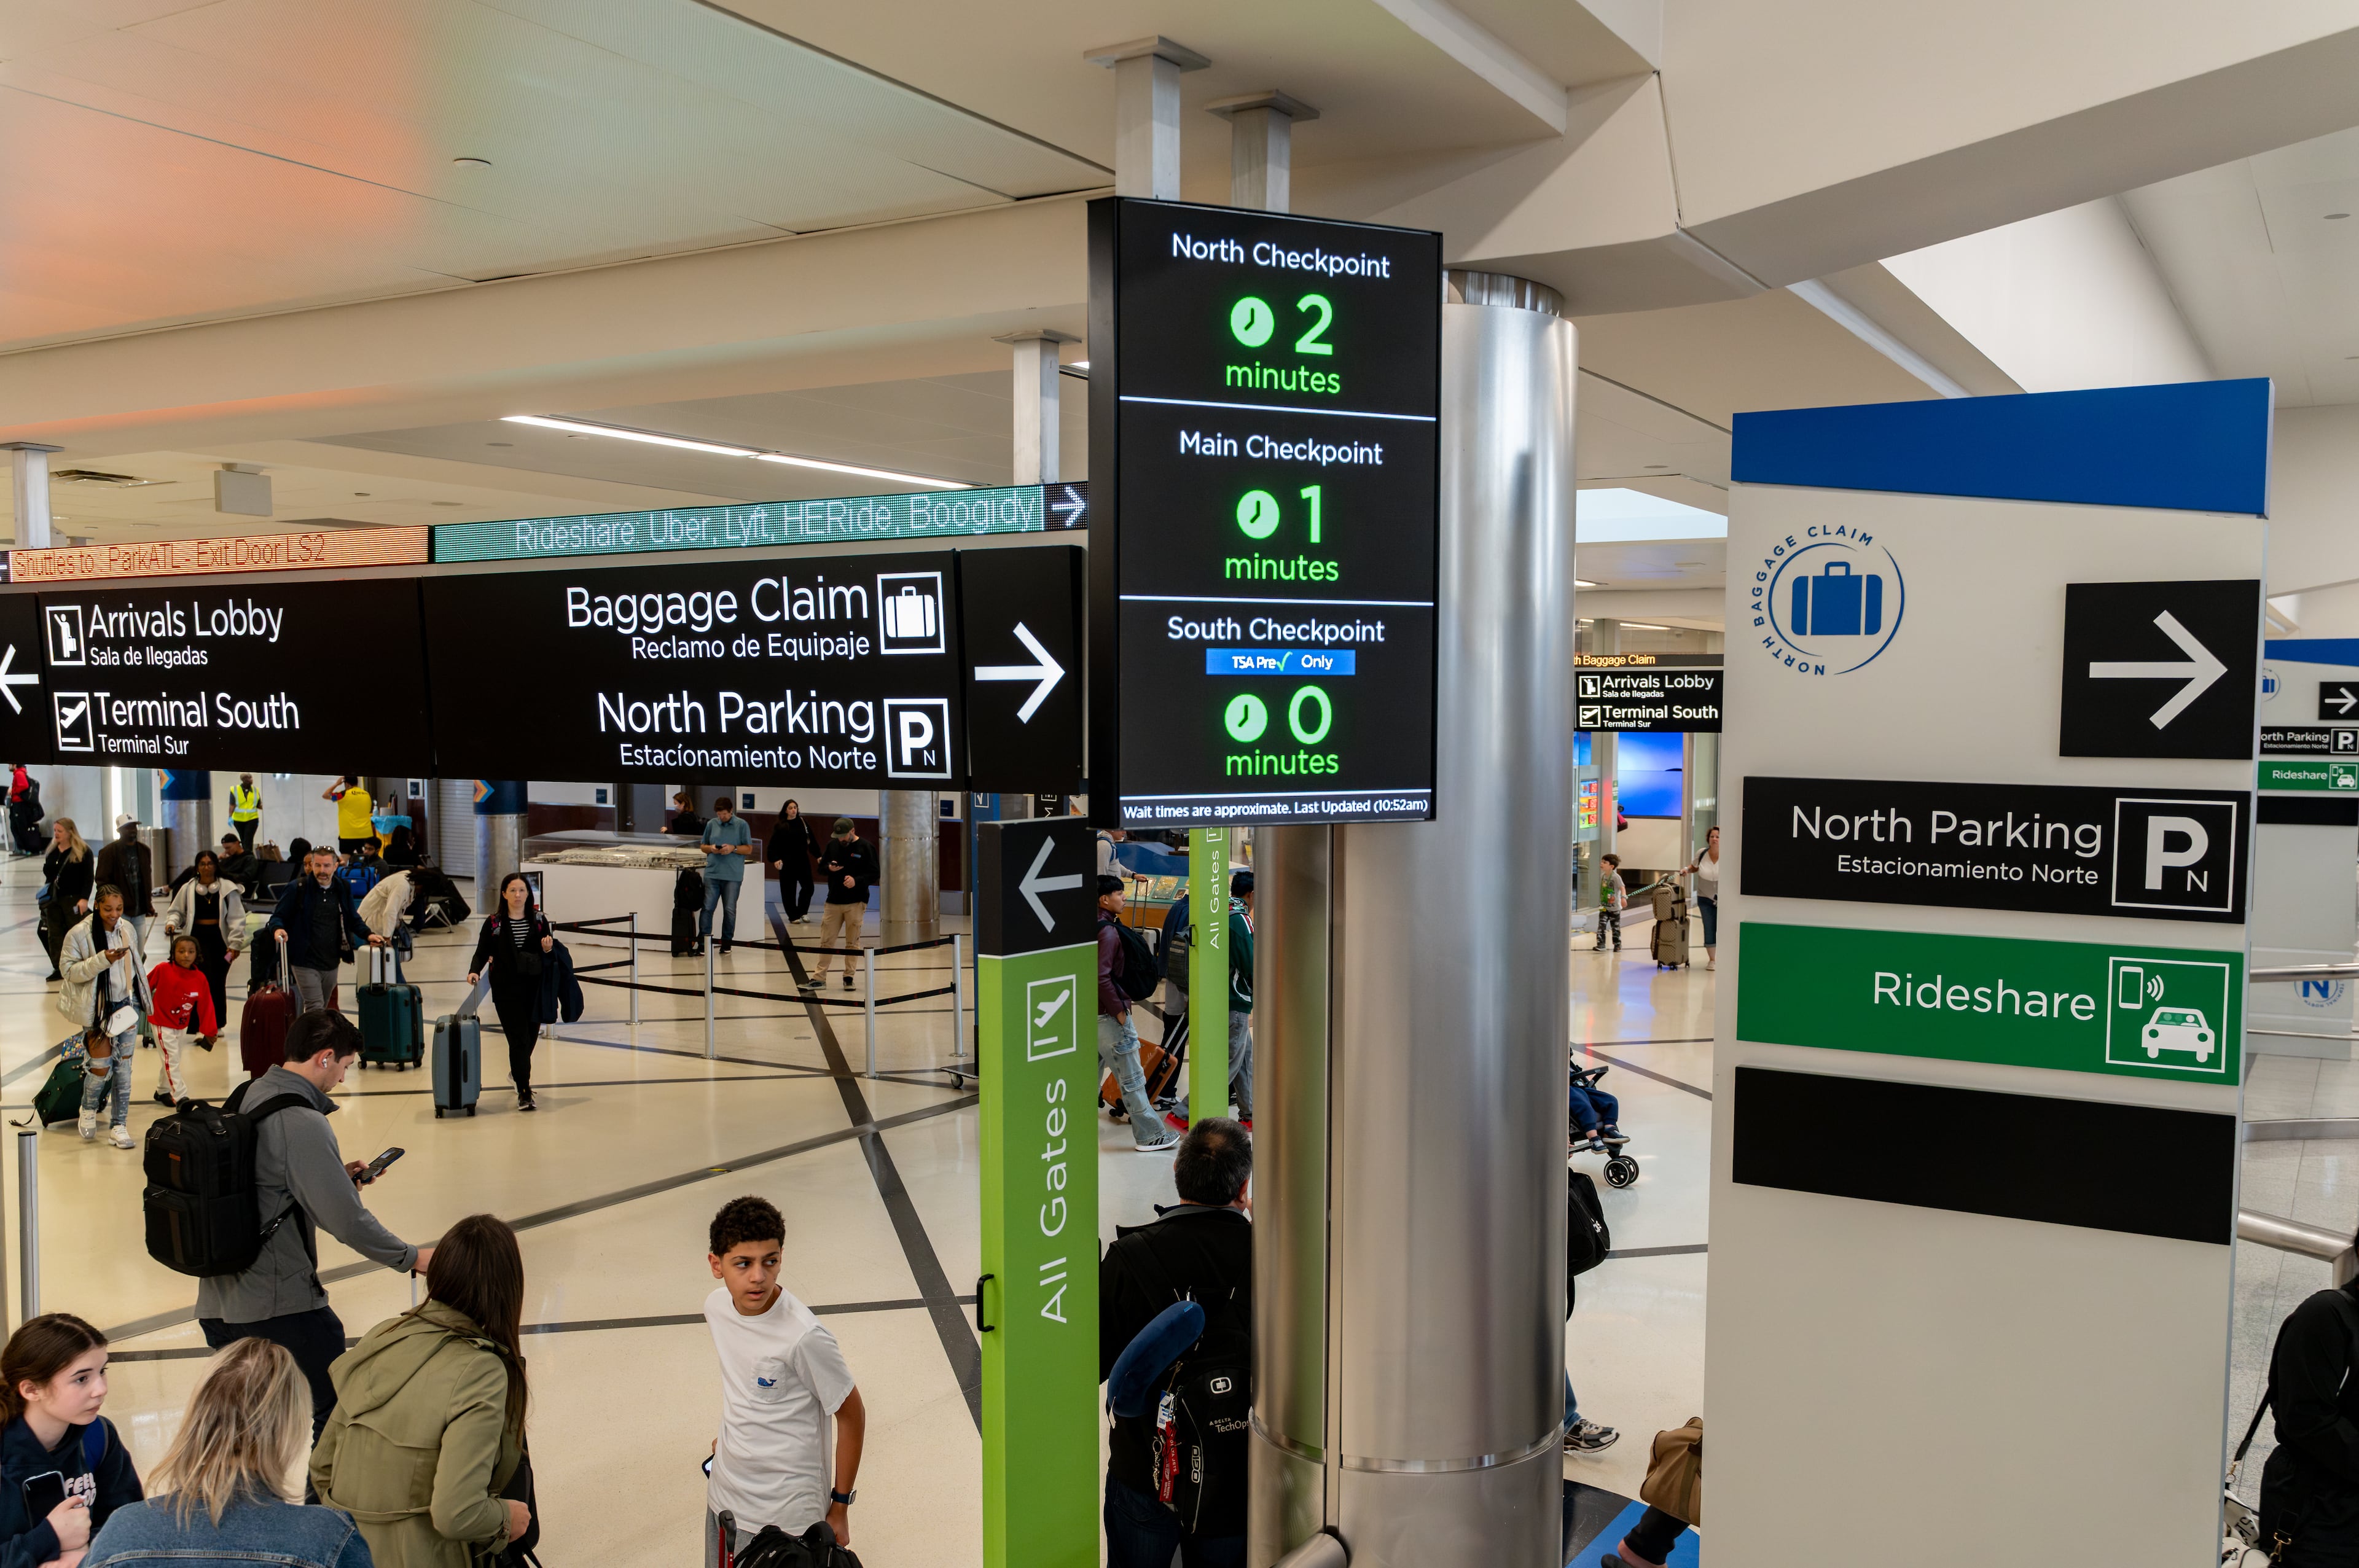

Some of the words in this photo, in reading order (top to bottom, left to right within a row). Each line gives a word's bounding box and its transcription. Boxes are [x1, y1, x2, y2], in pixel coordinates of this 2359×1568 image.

[1173, 233, 1244, 264] North
[1253, 242, 1390, 278] Checkpoint
[1295, 294, 1333, 356] 2
[1226, 361, 1340, 394] minutes
[1180, 430, 1238, 457] Main
[1246, 434, 1383, 467] Checkpoint
[649, 512, 717, 545] Uber,
[725, 507, 775, 547] Lyft,
[783, 499, 900, 536] HERide,
[909, 488, 1036, 534] Boogidy
[1300, 485, 1321, 544] 1
[1807, 524, 1874, 547] CLAIM
[15, 552, 74, 576] Shuttles
[109, 544, 181, 571] ParkATL
[197, 541, 230, 567] Exit
[235, 539, 281, 565] Door
[287, 534, 325, 562] LS2
[1226, 552, 1339, 582] minutes
[1751, 535, 1798, 626] BAGGAGE
[566, 587, 738, 634] Baggage
[751, 575, 868, 622] Claim
[88, 601, 186, 638] Arrivals
[194, 598, 283, 643] Lobby
[1168, 615, 1241, 641] South
[1249, 617, 1385, 646] Checkpoint
[90, 646, 120, 666] Sala
[123, 646, 143, 666] de
[146, 645, 208, 669] llegadas
[632, 635, 725, 659] Reclamo
[732, 633, 761, 658] de
[768, 631, 870, 661] Equipaje
[1582, 655, 1626, 667] Baggage
[1628, 654, 1656, 665] Claim
[1761, 635, 1825, 676] NORTH
[1232, 657, 1254, 669] TSA
[1301, 654, 1333, 670] Only
[1602, 674, 1661, 688] Arrivals
[1665, 674, 1714, 690] Lobby
[1632, 690, 1665, 699] llegadas
[93, 691, 208, 728] Terminal
[216, 692, 300, 729] South
[598, 690, 706, 733] North
[719, 689, 874, 743] Parking
[1288, 685, 1332, 745] 0
[1602, 704, 1668, 719] Terminal
[1672, 704, 1718, 719] South
[98, 734, 161, 754] Terminal
[164, 735, 189, 755] Sur
[899, 711, 935, 766] P
[2260, 731, 2284, 741] orth
[2287, 731, 2330, 743] Parking
[2337, 731, 2355, 751] P
[809, 746, 877, 770] Norte
[923, 749, 936, 766] N
[1226, 749, 1339, 776] minutes
[2272, 770, 2328, 779] Rideshare
[1123, 805, 1152, 819] Wait
[1155, 805, 1189, 818] times
[1191, 806, 1213, 817] are
[1214, 802, 1292, 818] approximate.
[1294, 801, 1320, 814] Last
[1321, 799, 1371, 814] Updated
[1373, 798, 1428, 814] (10:52am)
[1793, 805, 1912, 843] North
[1931, 810, 2102, 858] Parking
[2145, 815, 2208, 892] P
[1210, 850, 1219, 913] Gates
[1837, 854, 2023, 881] Estacionamiento
[2032, 864, 2099, 885] Norte
[2186, 870, 2208, 892] N
[1210, 922, 1219, 950] All
[1874, 972, 2095, 1021] Rideshare
[1039, 1078, 1067, 1237] Gates
[1039, 1257, 1067, 1324] All
[65, 1472, 96, 1495] FEEL
